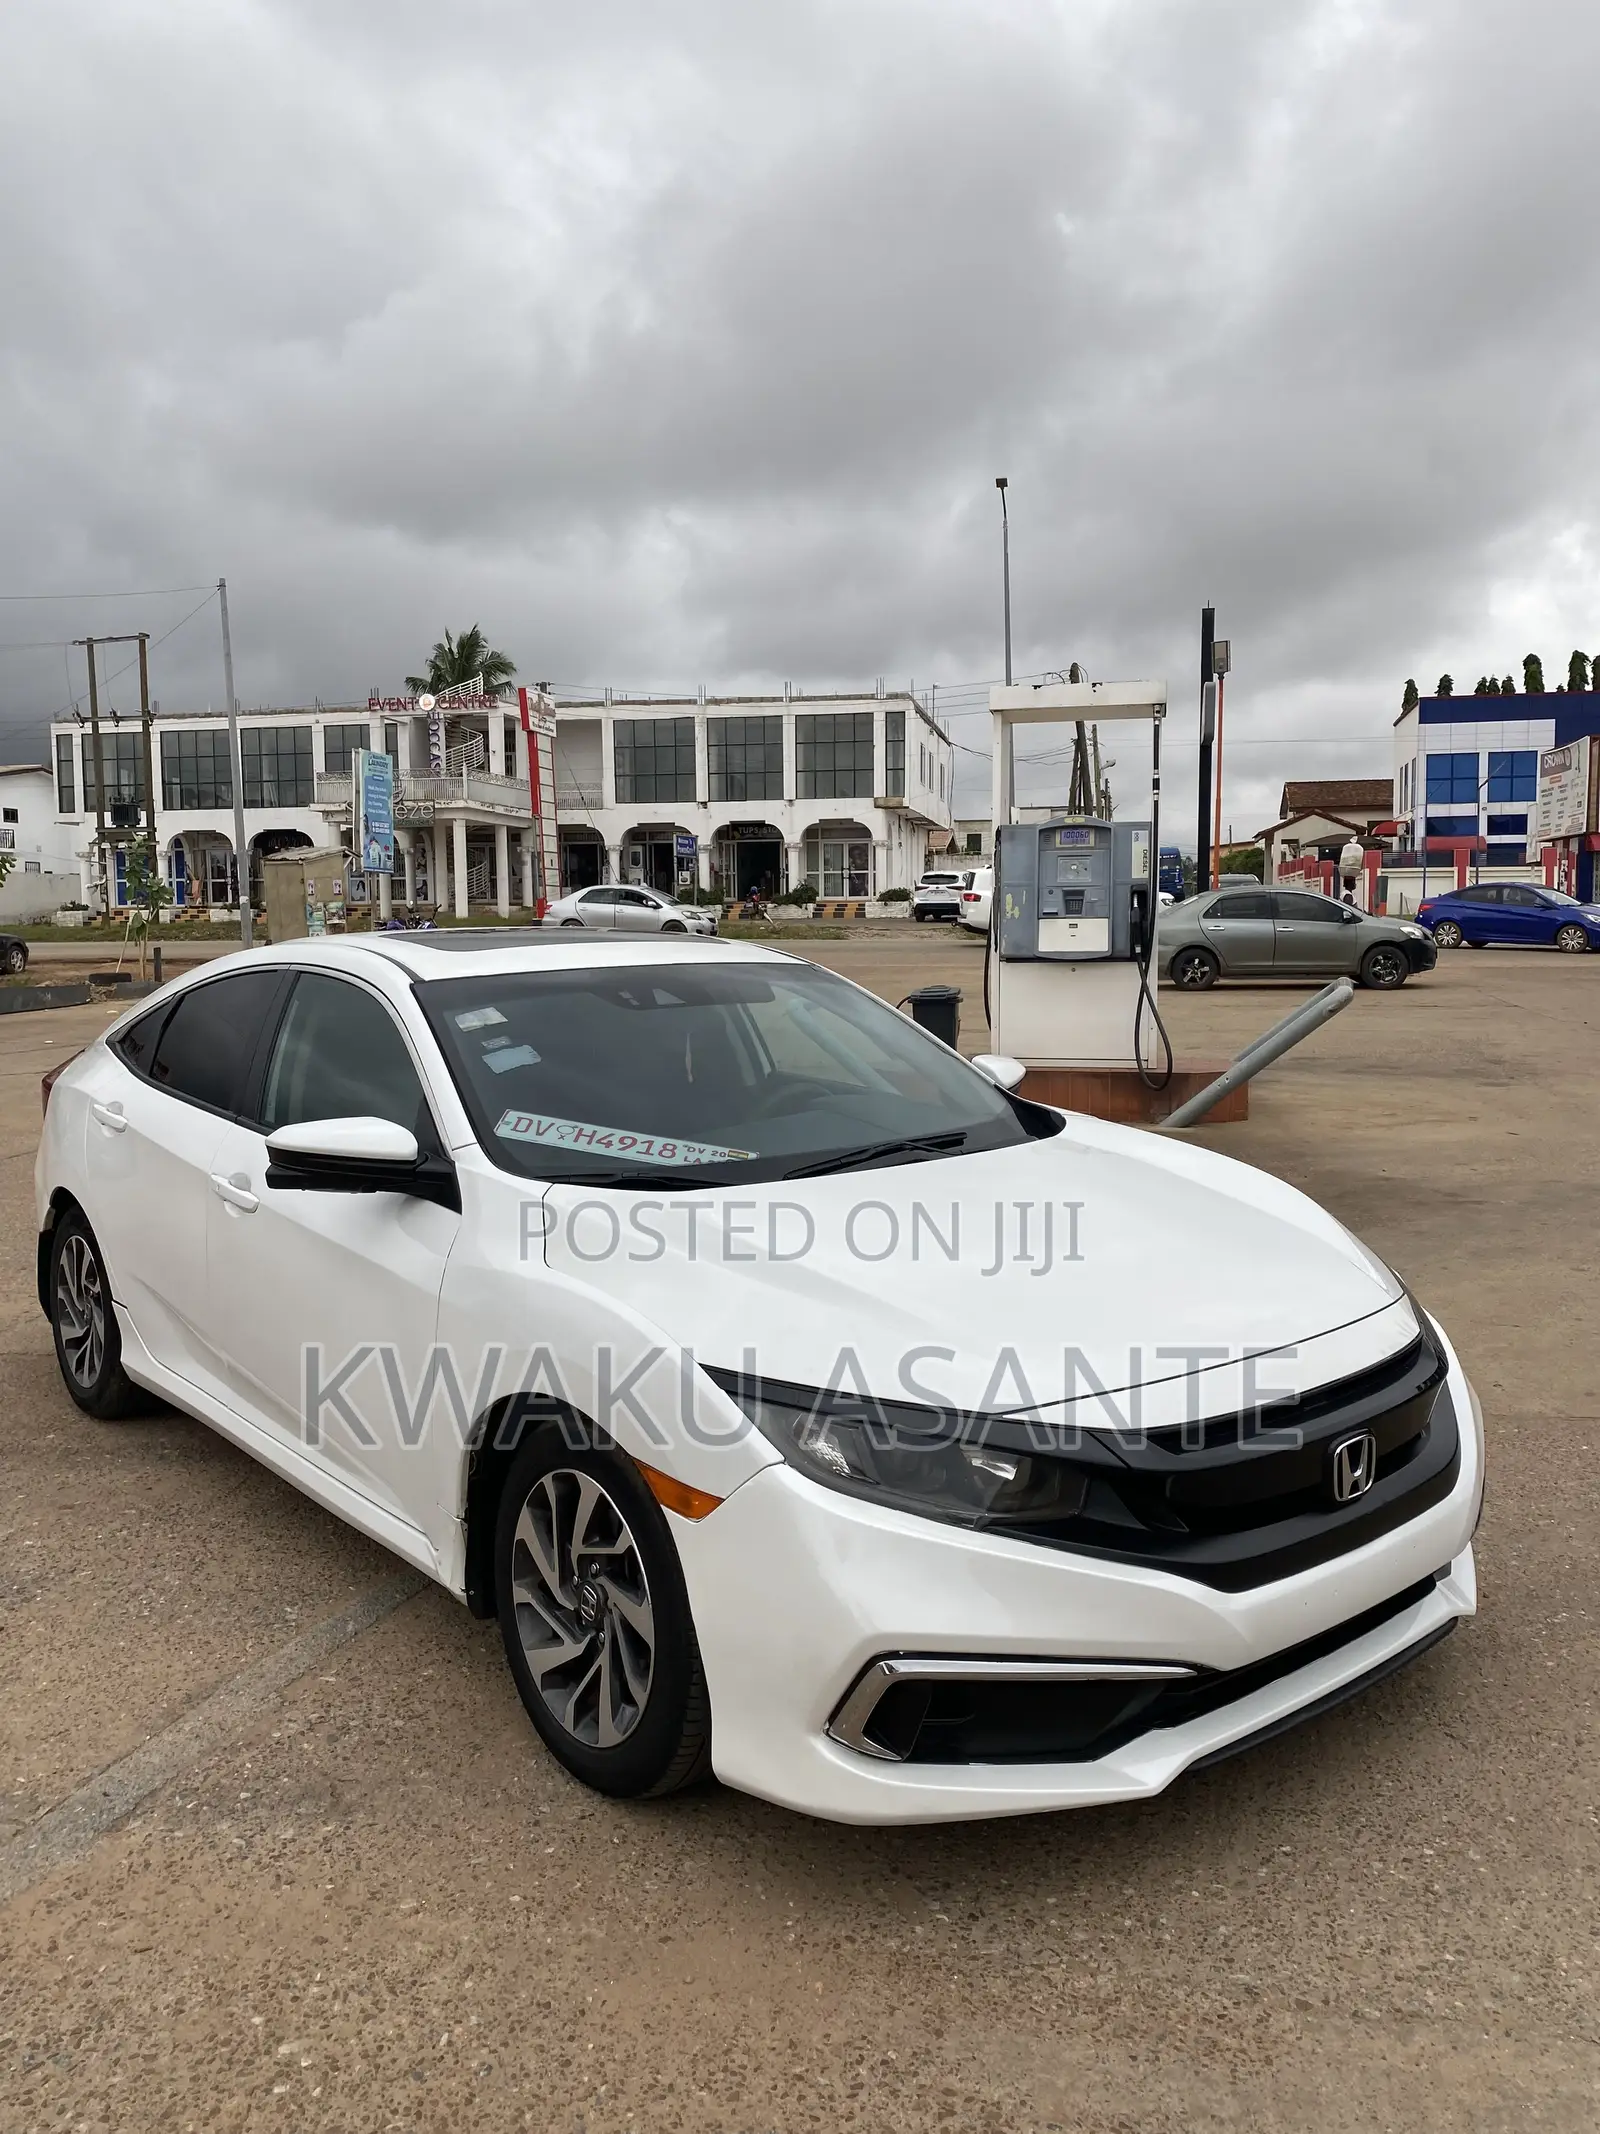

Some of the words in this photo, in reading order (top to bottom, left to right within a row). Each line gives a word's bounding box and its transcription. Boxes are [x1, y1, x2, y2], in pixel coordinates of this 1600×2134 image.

[368, 696, 418, 712] EVENT
[438, 693, 500, 710] CENTRE
[510, 1116, 554, 1136] DV
[573, 1127, 677, 1159] H4918
